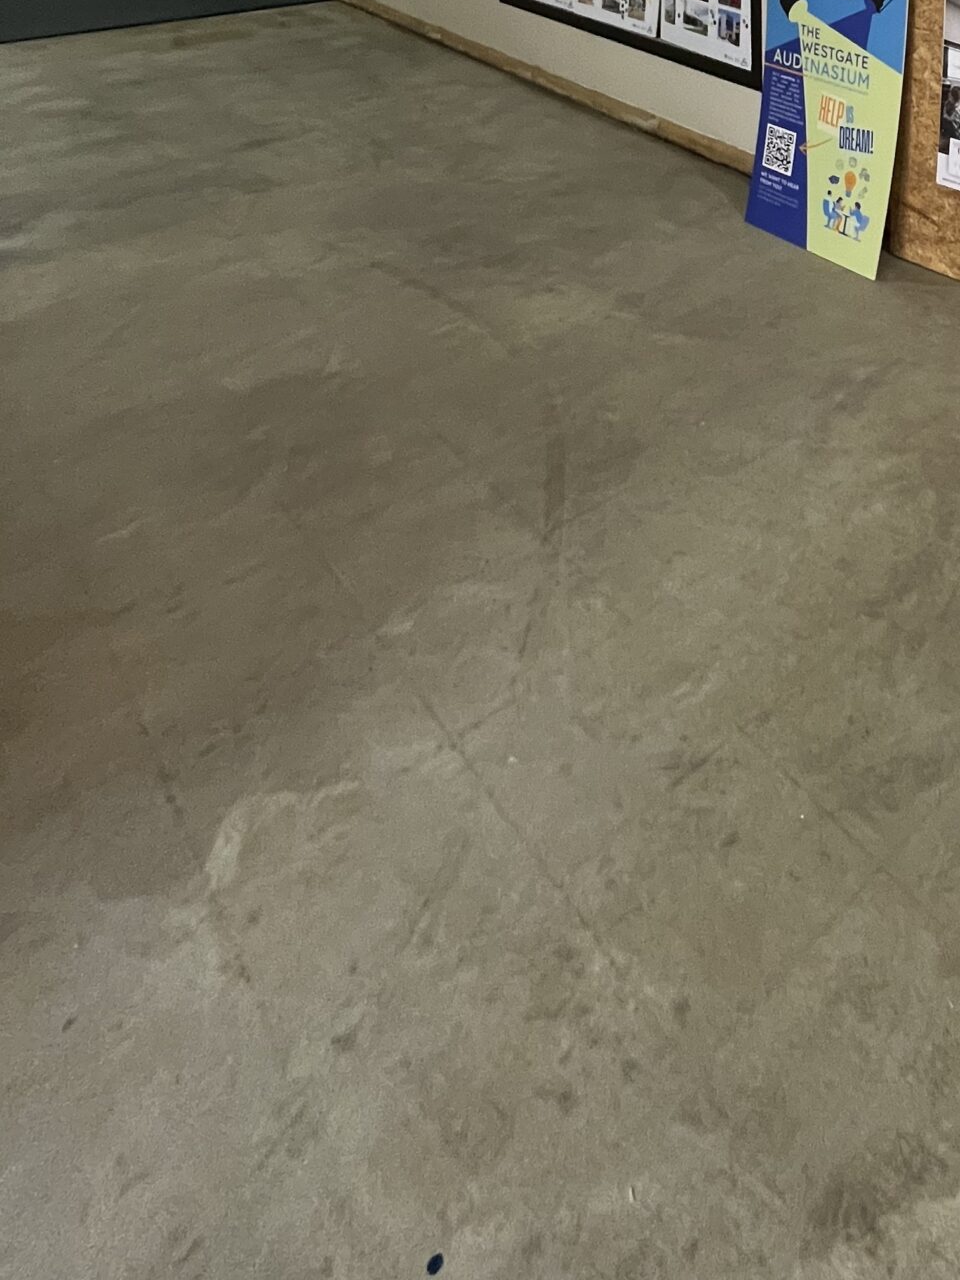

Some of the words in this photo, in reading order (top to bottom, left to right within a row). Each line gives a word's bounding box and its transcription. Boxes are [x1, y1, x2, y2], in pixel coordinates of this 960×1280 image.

[801, 23, 821, 39] THE
[773, 47, 870, 89] AUDINASIUM
[801, 39, 869, 70] WESTGATE
[818, 94, 845, 128] HELP
[839, 125, 874, 154] DREAM!
